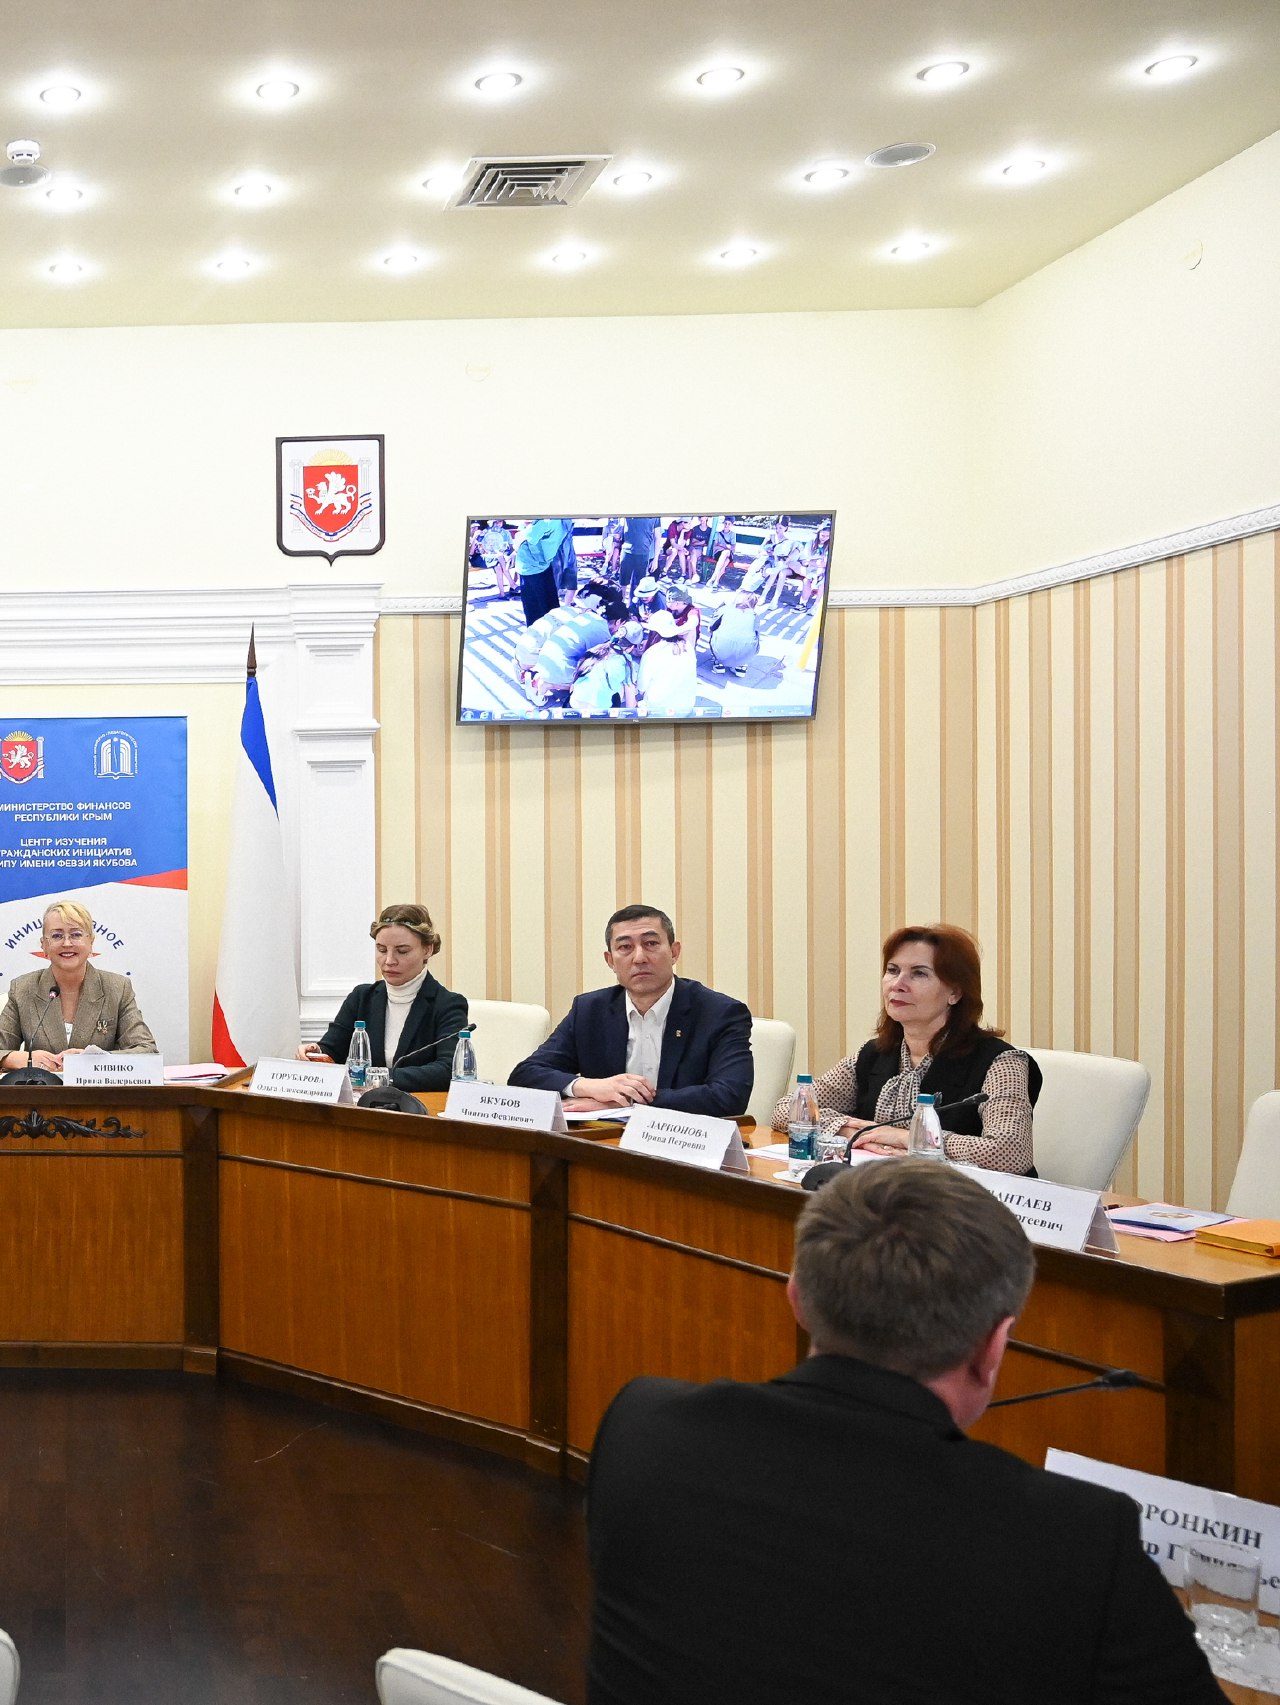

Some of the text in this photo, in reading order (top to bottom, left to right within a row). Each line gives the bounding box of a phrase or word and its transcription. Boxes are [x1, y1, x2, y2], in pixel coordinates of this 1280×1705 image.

[76, 802, 131, 811] ФИНАНСОВ
[14, 812, 112, 822] РЕСПУБЛИКИ КРЫМ
[20, 838, 108, 847] ЦЕНТР ИЗУЧЕНИЯ
[72, 848, 132, 858] ИНИЦИАТИВ
[20, 860, 55, 868] ИМЕНИ
[57, 859, 91, 868] ФЕВЗИ
[92, 858, 138, 867] ЯКУБОВА
[94, 1064, 134, 1072] КИВИКО
[271, 1072, 324, 1084] ТОРУБАРОВА
[480, 1096, 520, 1108] ЯКУБОВ
[646, 1120, 708, 1139] ЛАРИОНОВА
[668, 1136, 706, 1150] Петровна
[989, 1189, 1052, 1212] АНТАЕВ
[1140, 1502, 1264, 1550] РОНКИН
